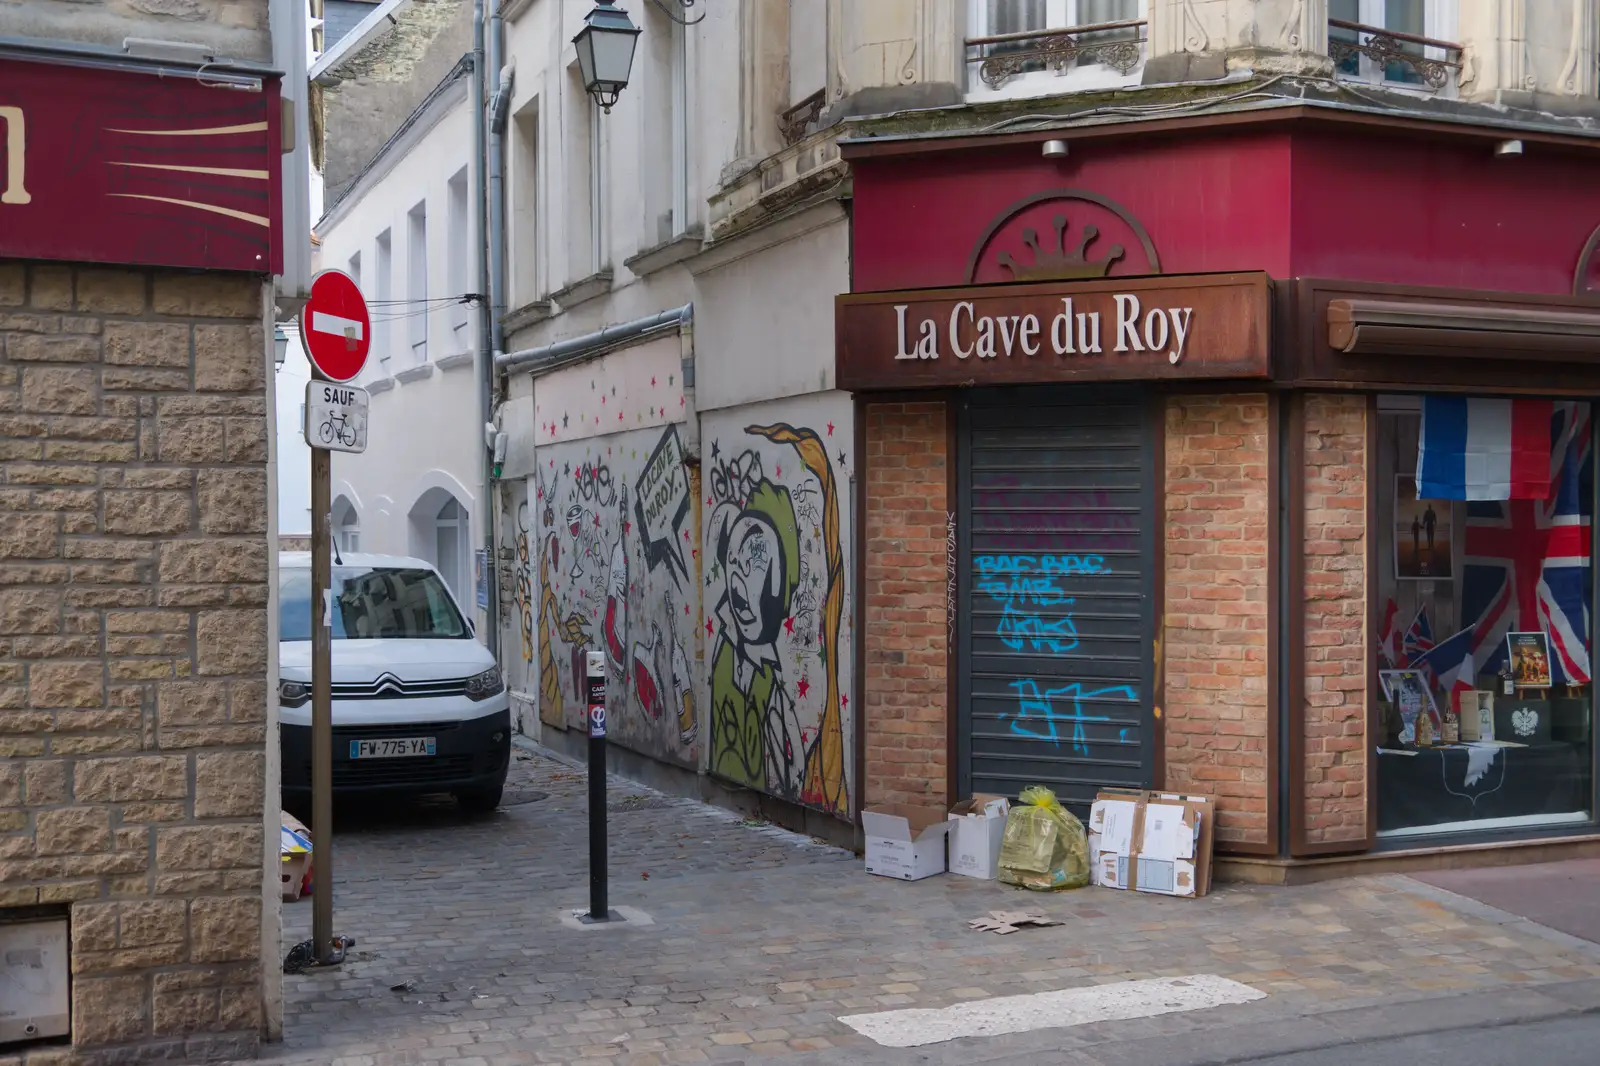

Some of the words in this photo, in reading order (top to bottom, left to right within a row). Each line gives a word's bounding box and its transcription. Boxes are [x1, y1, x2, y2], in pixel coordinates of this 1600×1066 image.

[893, 304, 939, 360] La
[949, 301, 1041, 359] Cave
[1050, 297, 1102, 355] du
[1112, 293, 1193, 365] Roy
[324, 387, 355, 407] SAUF
